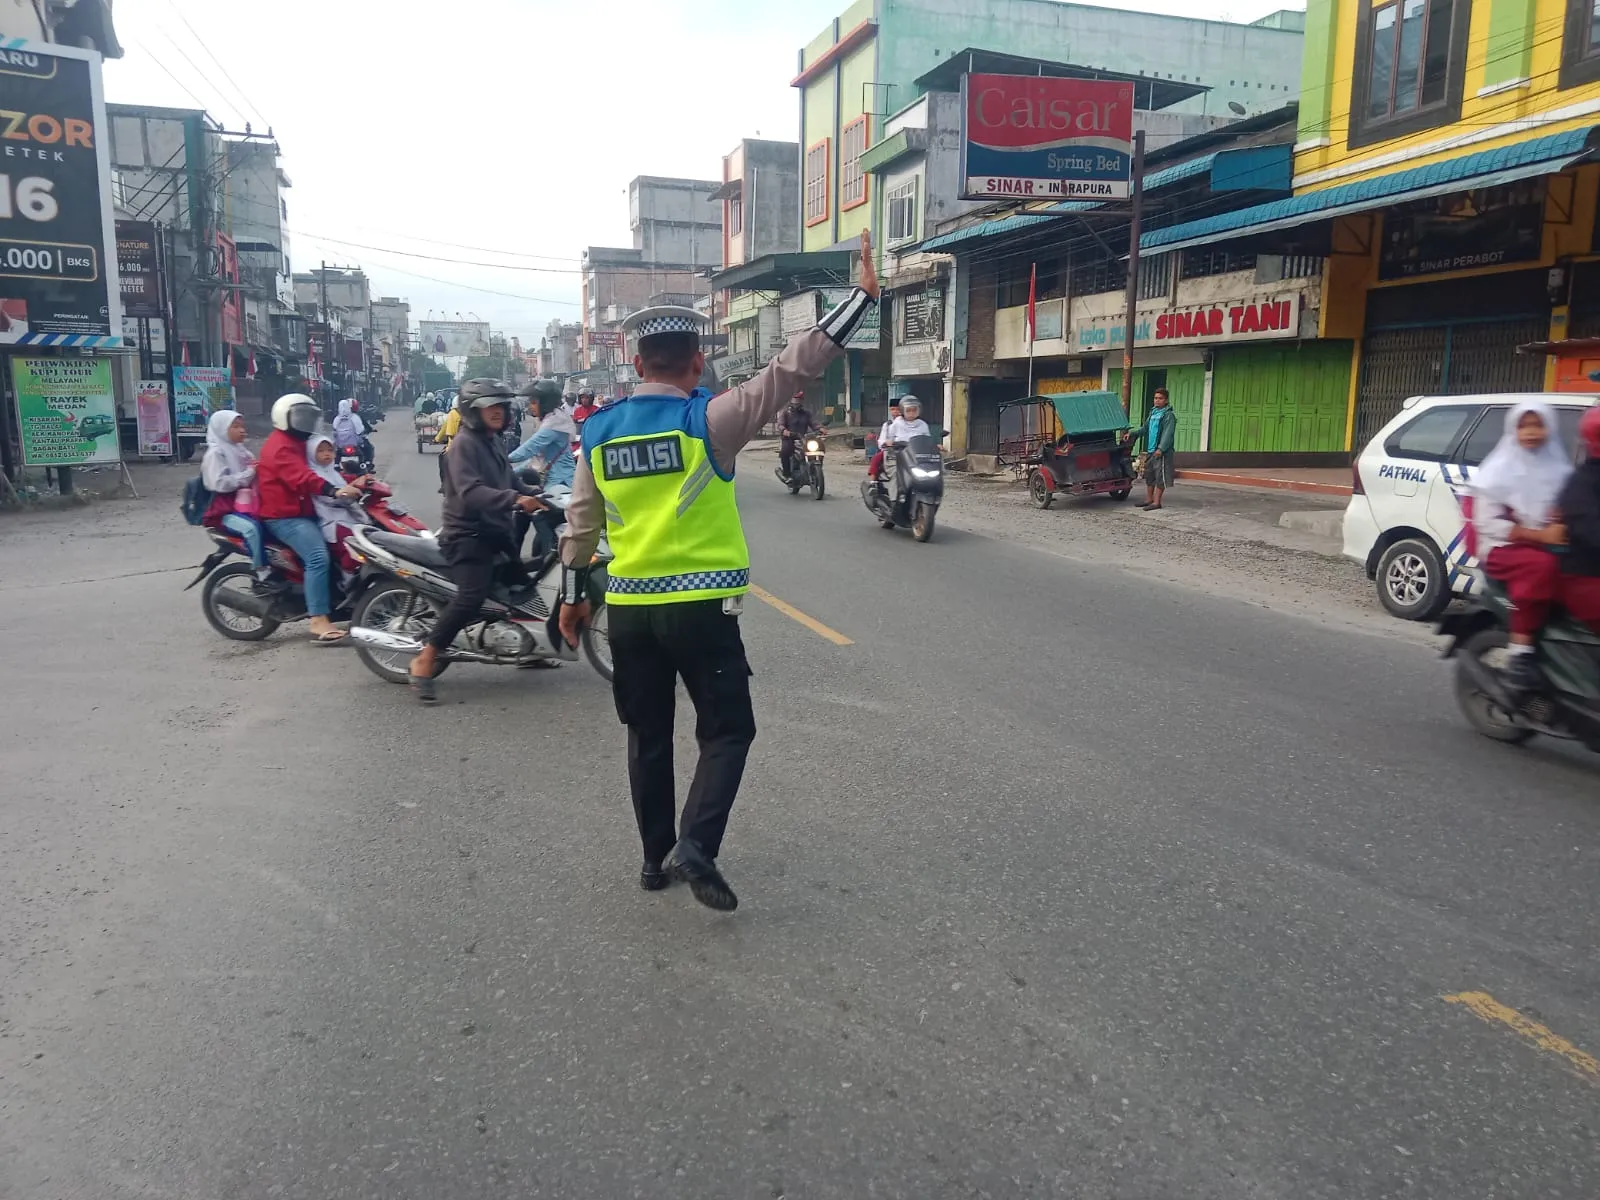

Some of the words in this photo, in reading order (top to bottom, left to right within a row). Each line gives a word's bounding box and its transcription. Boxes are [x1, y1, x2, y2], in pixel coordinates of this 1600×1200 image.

[975, 88, 1118, 131] Caisar
[0, 109, 93, 148] ZOR
[4, 145, 64, 162] ETEK
[1047, 153, 1093, 173] Spring
[1096, 155, 1121, 171] Bed
[986, 178, 1034, 194] SINAR
[66, 257, 91, 267] BKS
[1419, 258, 1451, 272] SINAR
[1453, 251, 1505, 267] PERABOT
[1155, 309, 1224, 340] SINAR
[1228, 300, 1292, 334] TANI
[25, 360, 98, 368] PERWAKILAN
[605, 440, 680, 476] POLISI
[1378, 464, 1427, 483] PATWAL
